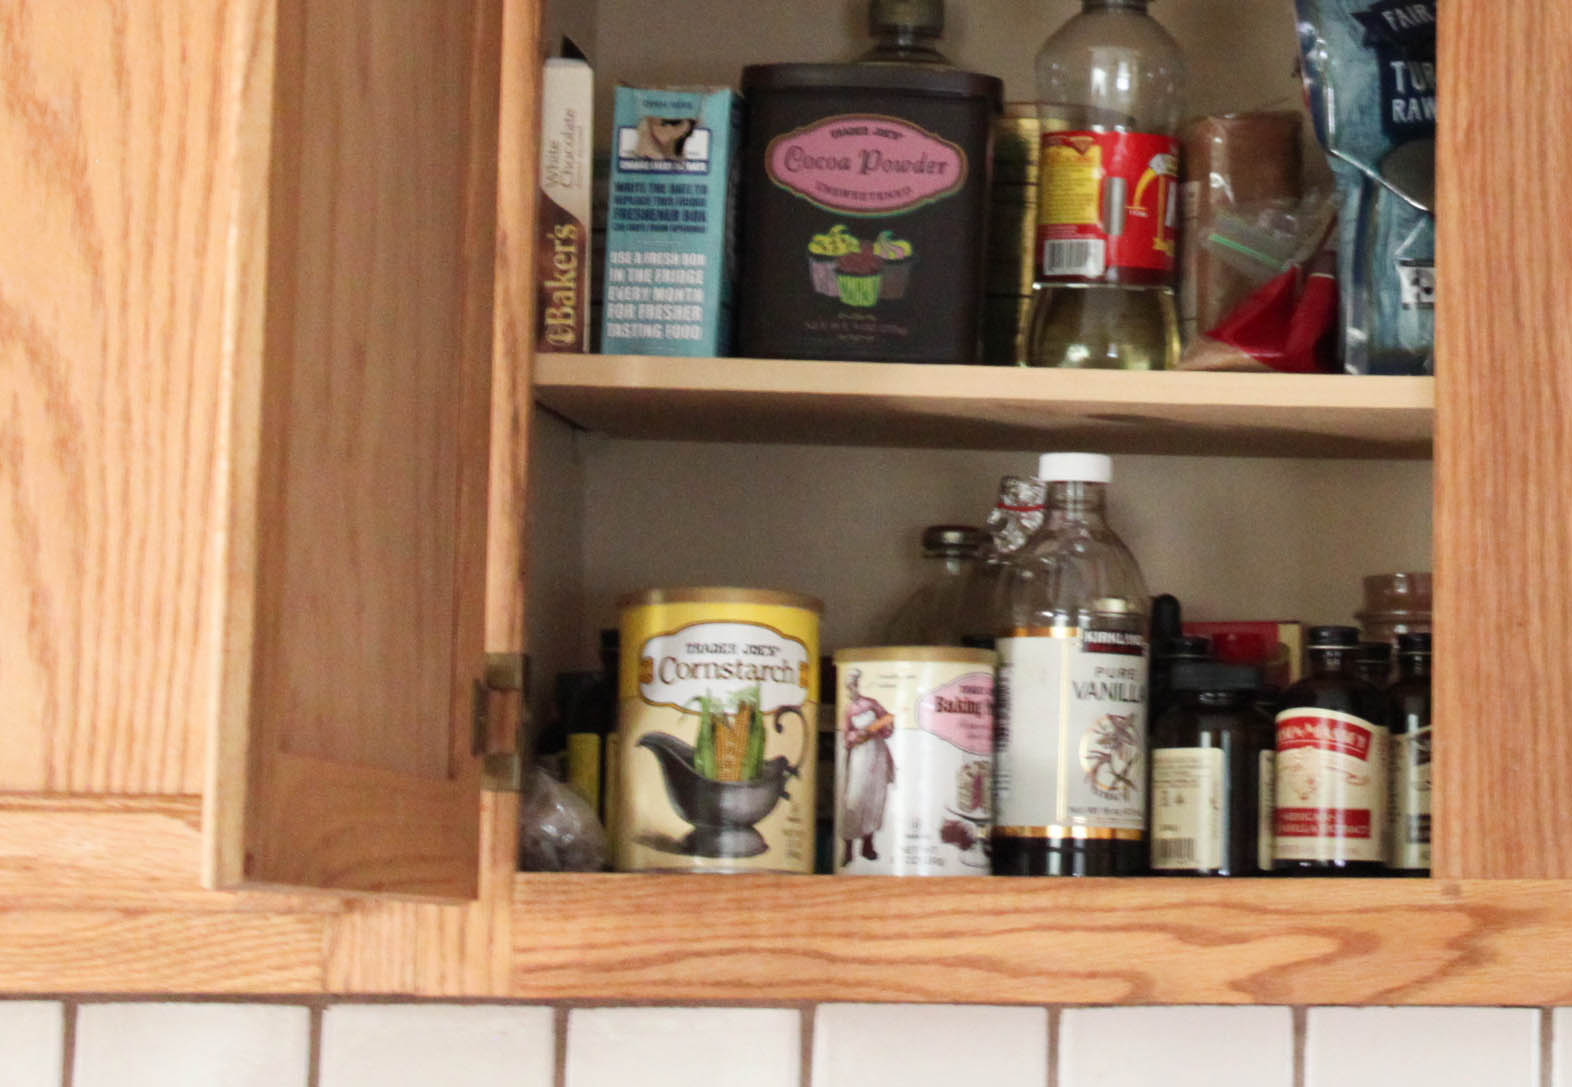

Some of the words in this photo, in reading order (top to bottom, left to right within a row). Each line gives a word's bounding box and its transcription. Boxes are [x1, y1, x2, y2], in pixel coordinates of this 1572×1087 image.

[1382, 4, 1434, 31] FAIR
[784, 145, 851, 174] Cocoa
[858, 148, 948, 175] Powder
[544, 223, 577, 326] Baker's
[608, 286, 650, 301] EVERY
[607, 303, 636, 320] FOR
[638, 303, 704, 321] FRESHER
[659, 655, 795, 685] Cornstarch
[1094, 666, 1136, 681] PURE
